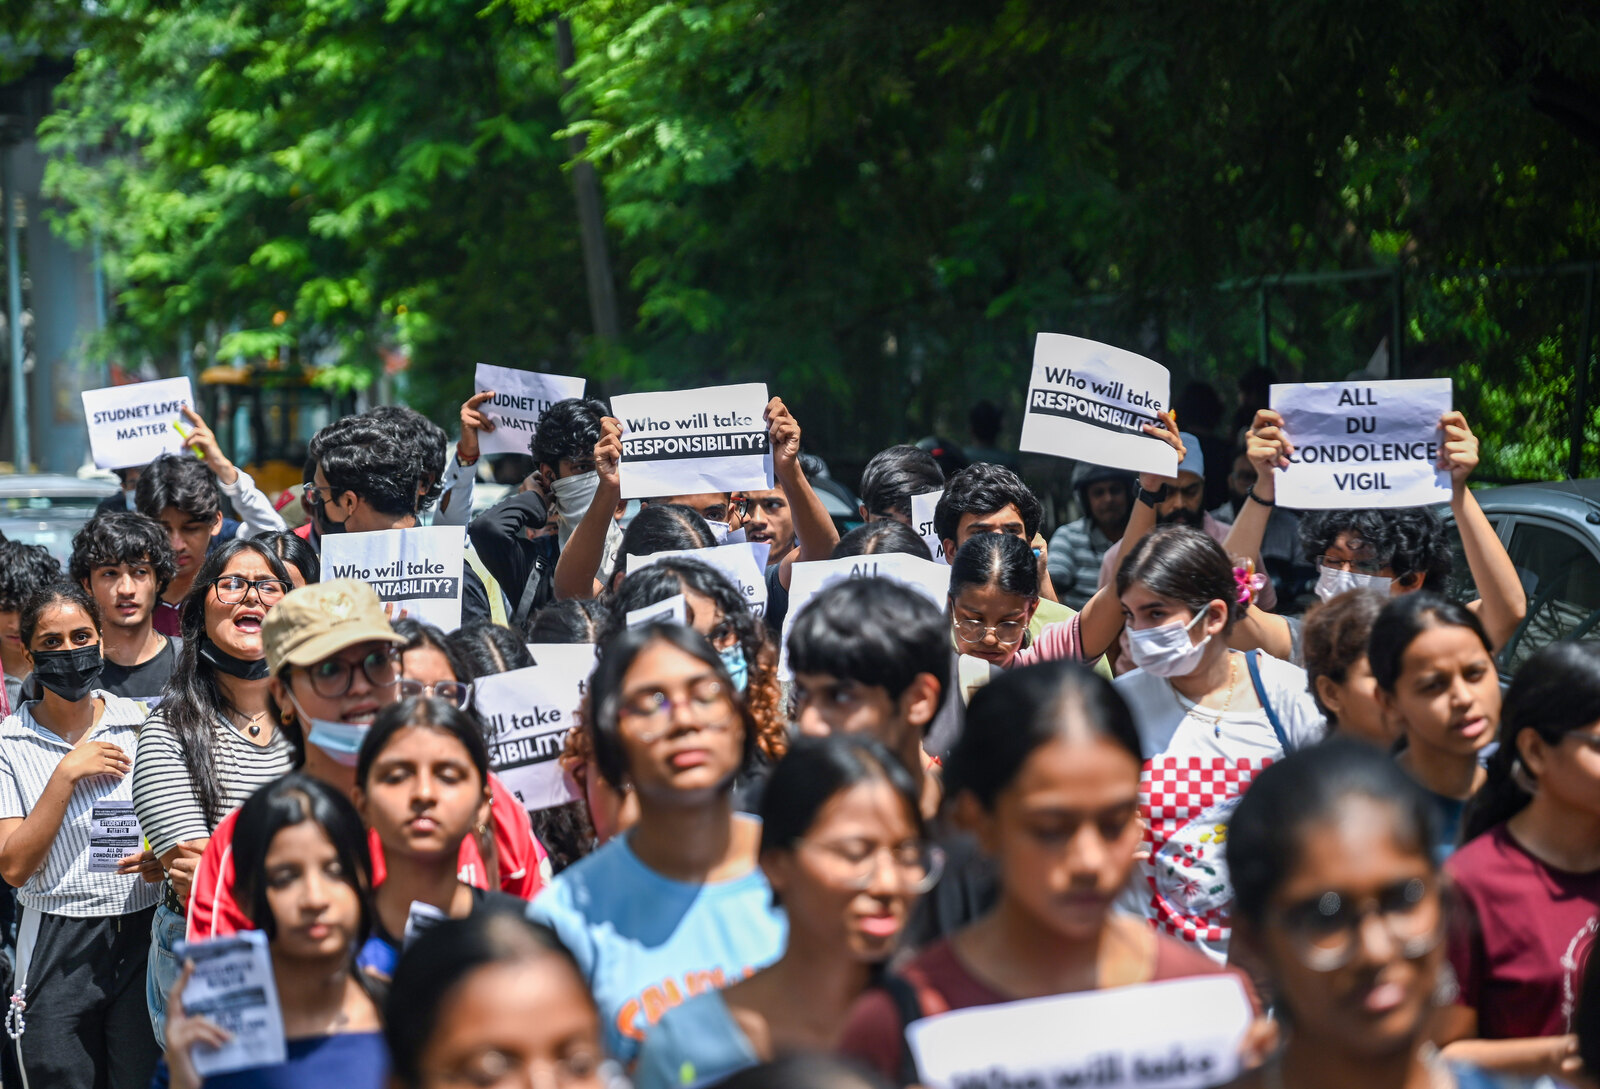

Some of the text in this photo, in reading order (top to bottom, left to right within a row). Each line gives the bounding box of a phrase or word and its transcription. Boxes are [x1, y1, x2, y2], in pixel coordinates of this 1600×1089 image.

[1045, 366, 1162, 411] Who will take
[1337, 388, 1377, 406] ALL
[94, 404, 150, 424] STUDNET
[501, 416, 538, 432] MATT
[626, 411, 752, 433] Who will take
[116, 423, 167, 440] MATTER
[1346, 416, 1376, 434] DU
[622, 433, 766, 456] RESPONSIBILITY?
[1289, 442, 1437, 463] CONDOLENCE
[1333, 472, 1391, 490] VIGIL
[333, 558, 445, 579] Who will take
[372, 579, 452, 596] NTABILITY?
[491, 706, 561, 733] ll take
